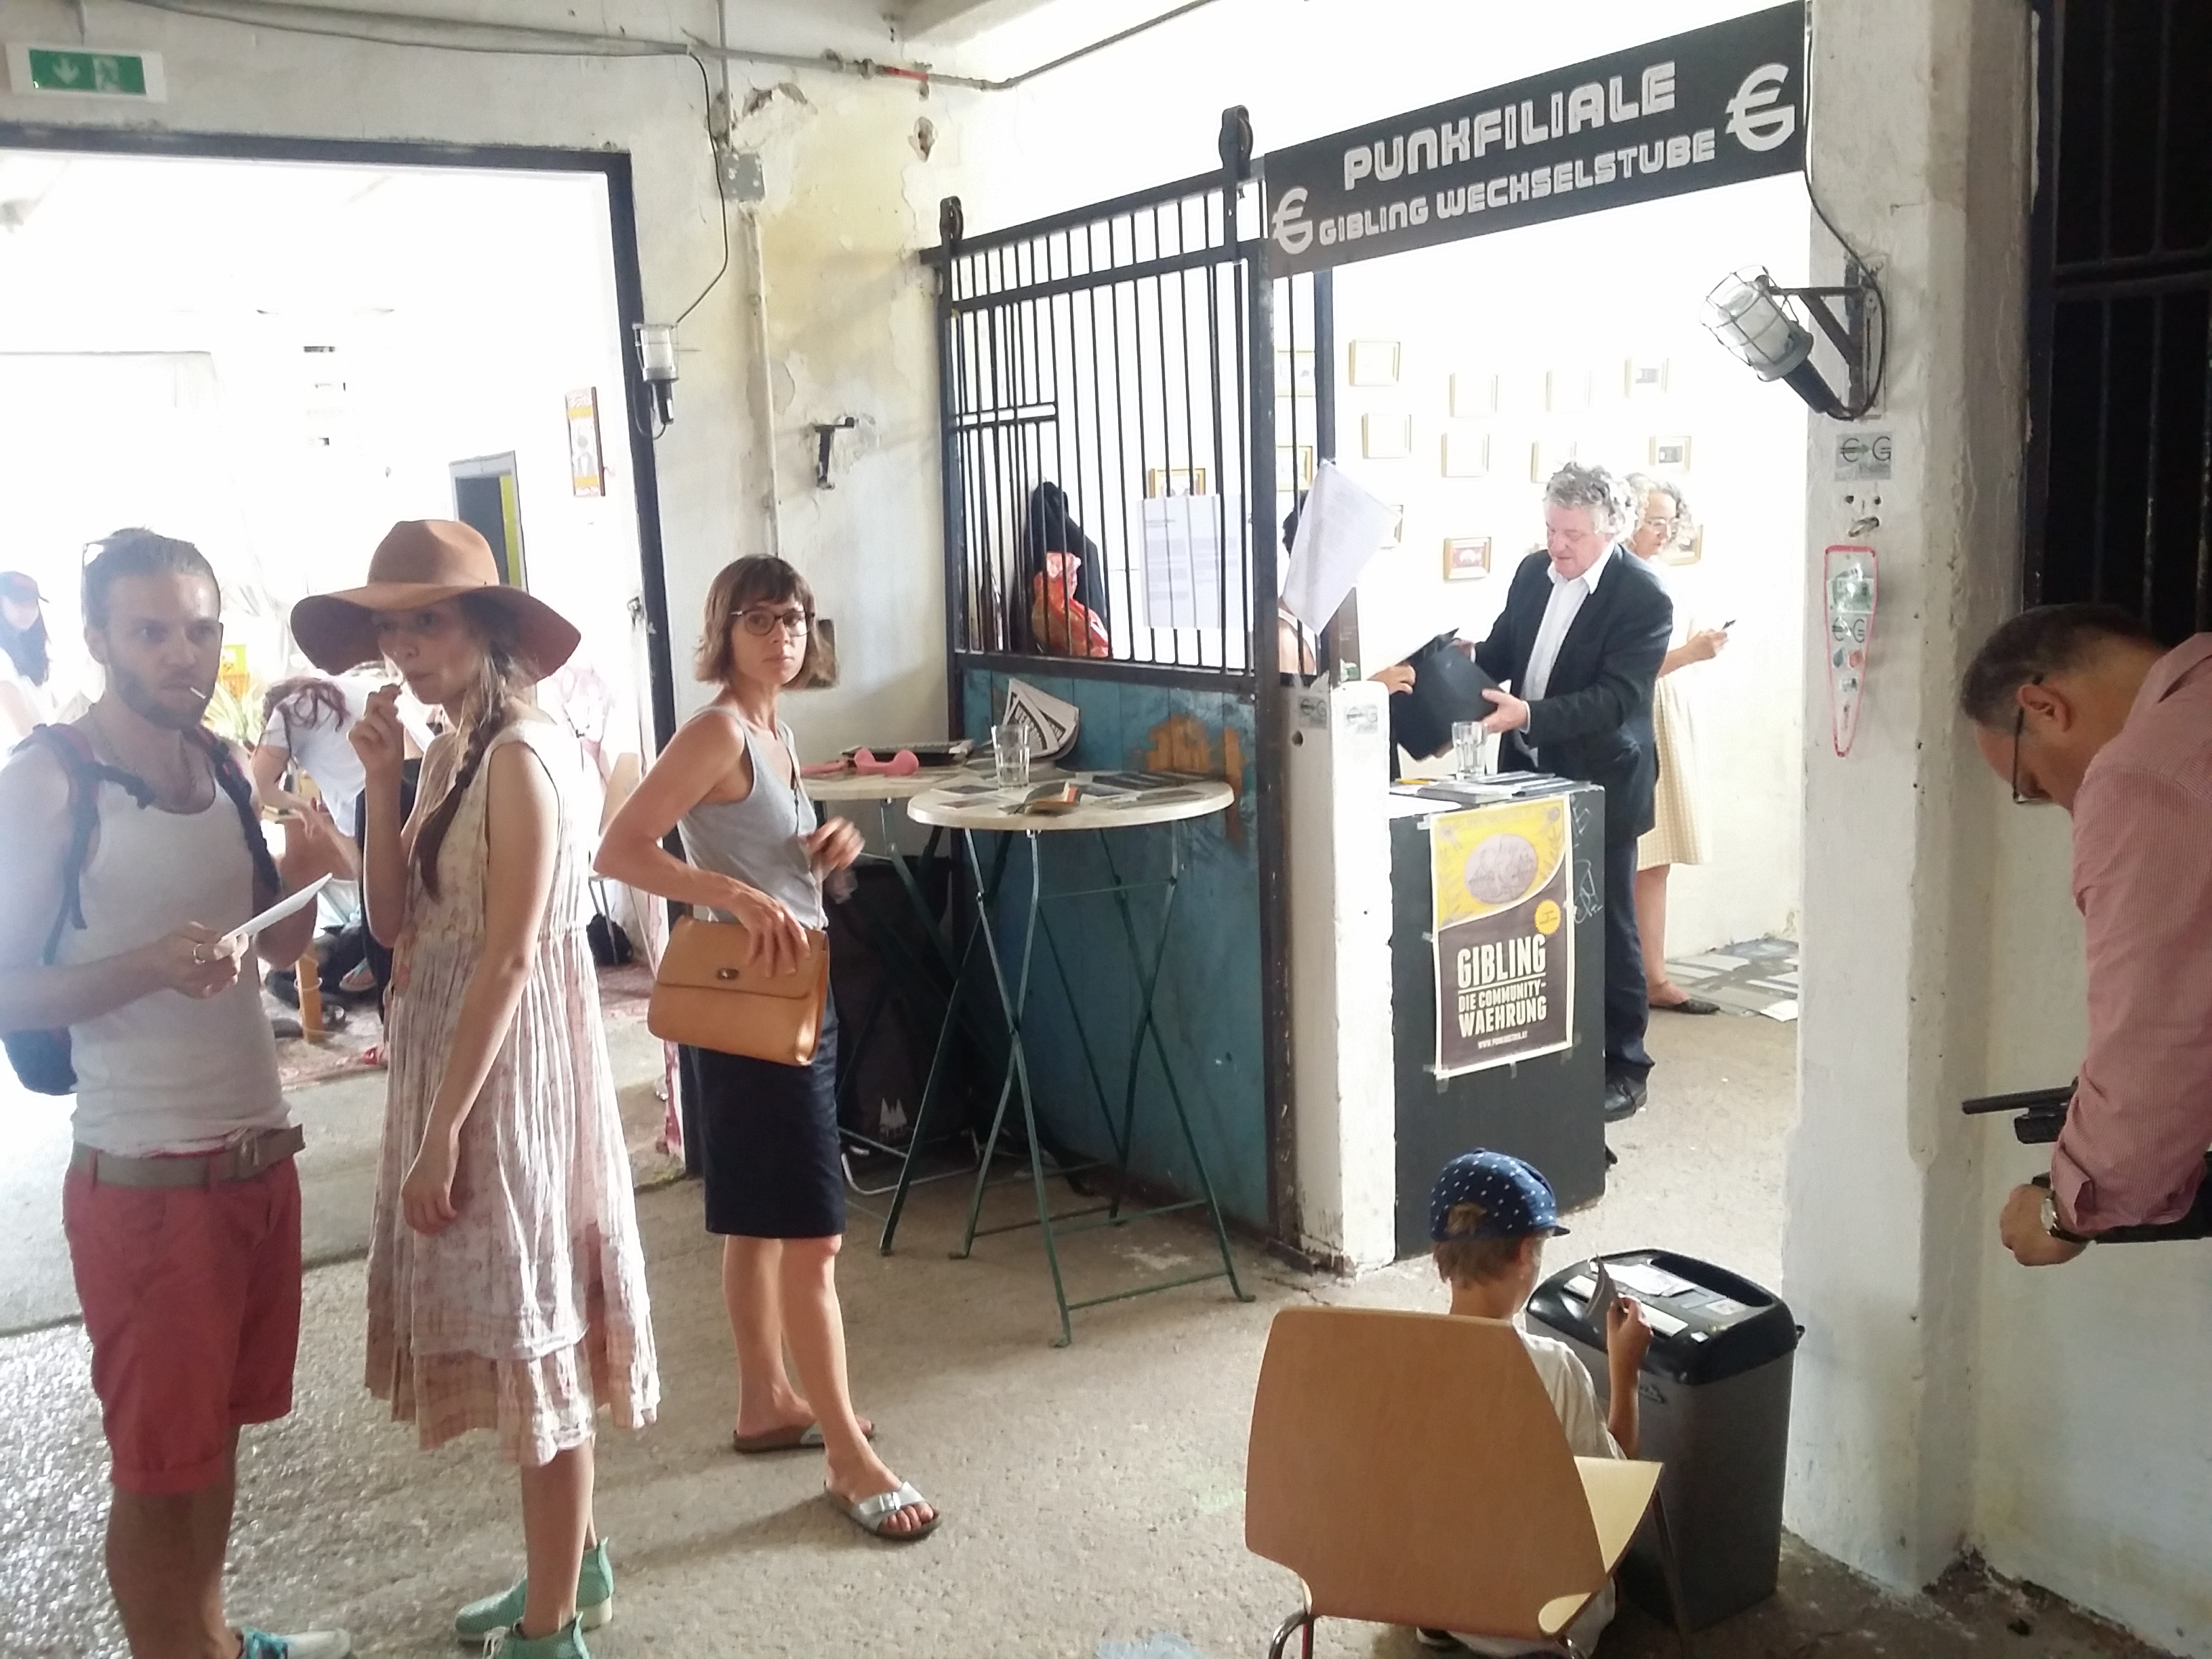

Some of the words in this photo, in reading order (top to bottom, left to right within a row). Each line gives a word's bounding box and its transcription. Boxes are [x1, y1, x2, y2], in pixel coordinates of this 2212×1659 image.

[1343, 61, 1676, 190] PUNKFILIALE
[1319, 196, 1429, 245] GIBLING
[1436, 129, 1716, 219] WECHSELSTUBE
[1458, 934, 1546, 988] GIBLING
[1458, 994, 1476, 1012] DIE
[1479, 979, 1547, 1008] COMMUNITY-
[1458, 996, 1547, 1038] WAEHRUNG
